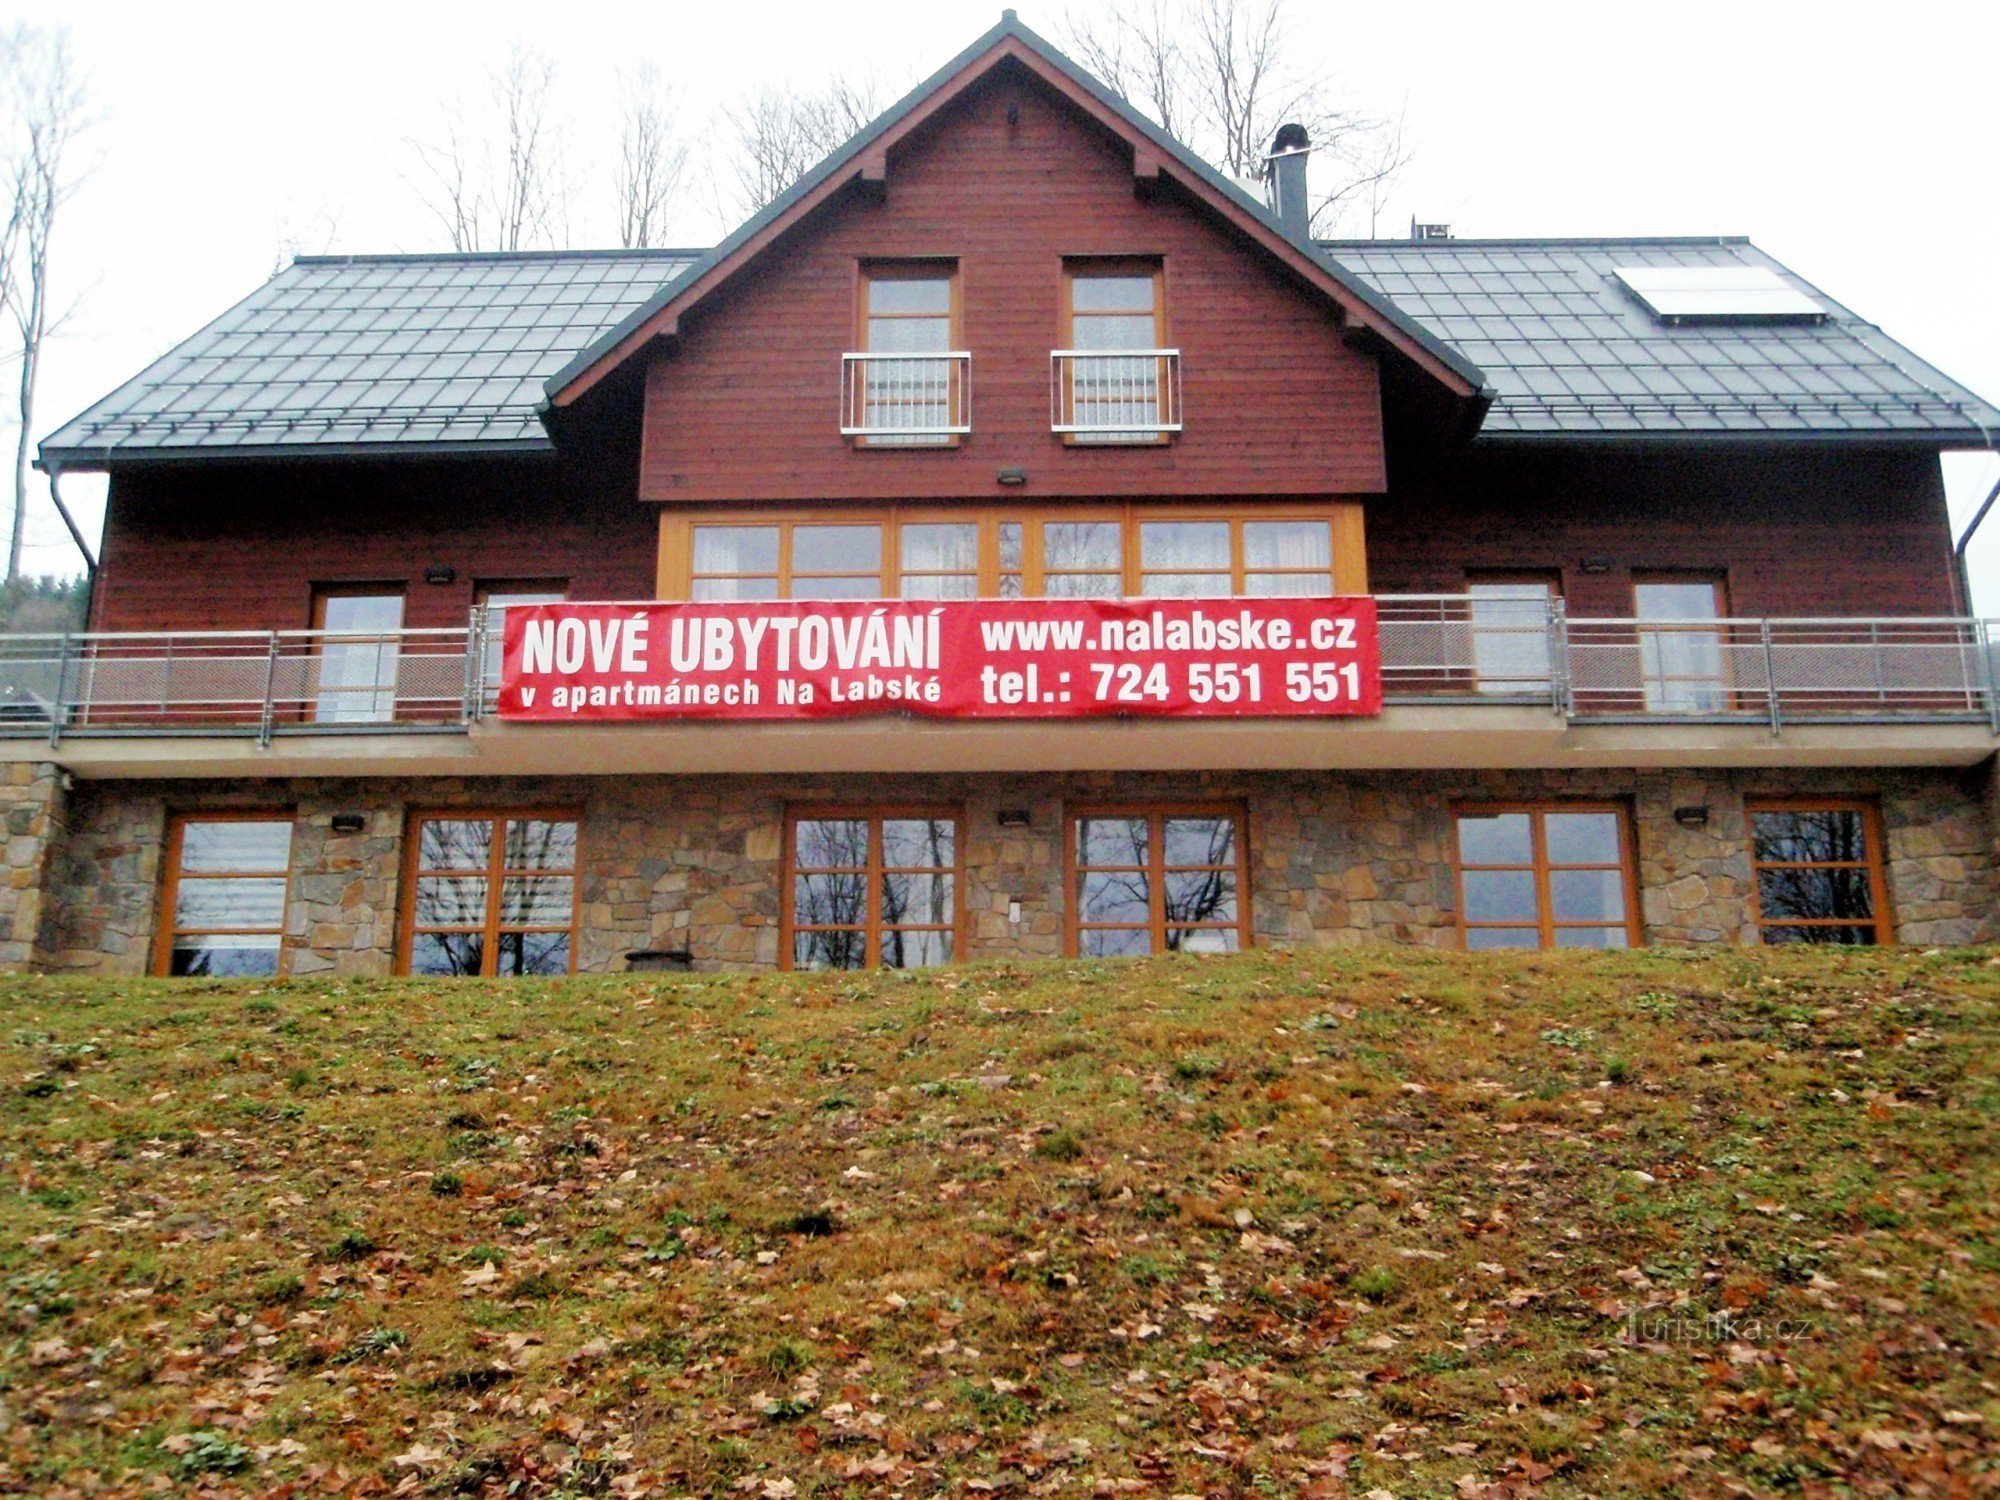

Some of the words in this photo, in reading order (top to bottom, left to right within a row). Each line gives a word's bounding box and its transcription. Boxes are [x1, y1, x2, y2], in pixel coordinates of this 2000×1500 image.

[521, 612, 650, 674] NOVÉ
[670, 608, 945, 672] UBYTOVÁNÍ
[981, 611, 1357, 651] www.nalabske.cz
[521, 687, 536, 708] v
[552, 681, 759, 711] apartmánech
[777, 679, 814, 704] Na
[830, 674, 941, 703] Labské
[981, 665, 1071, 703] tel.:
[1090, 663, 1170, 700] 724
[1188, 663, 1261, 703] 551
[1286, 662, 1360, 702] 551
